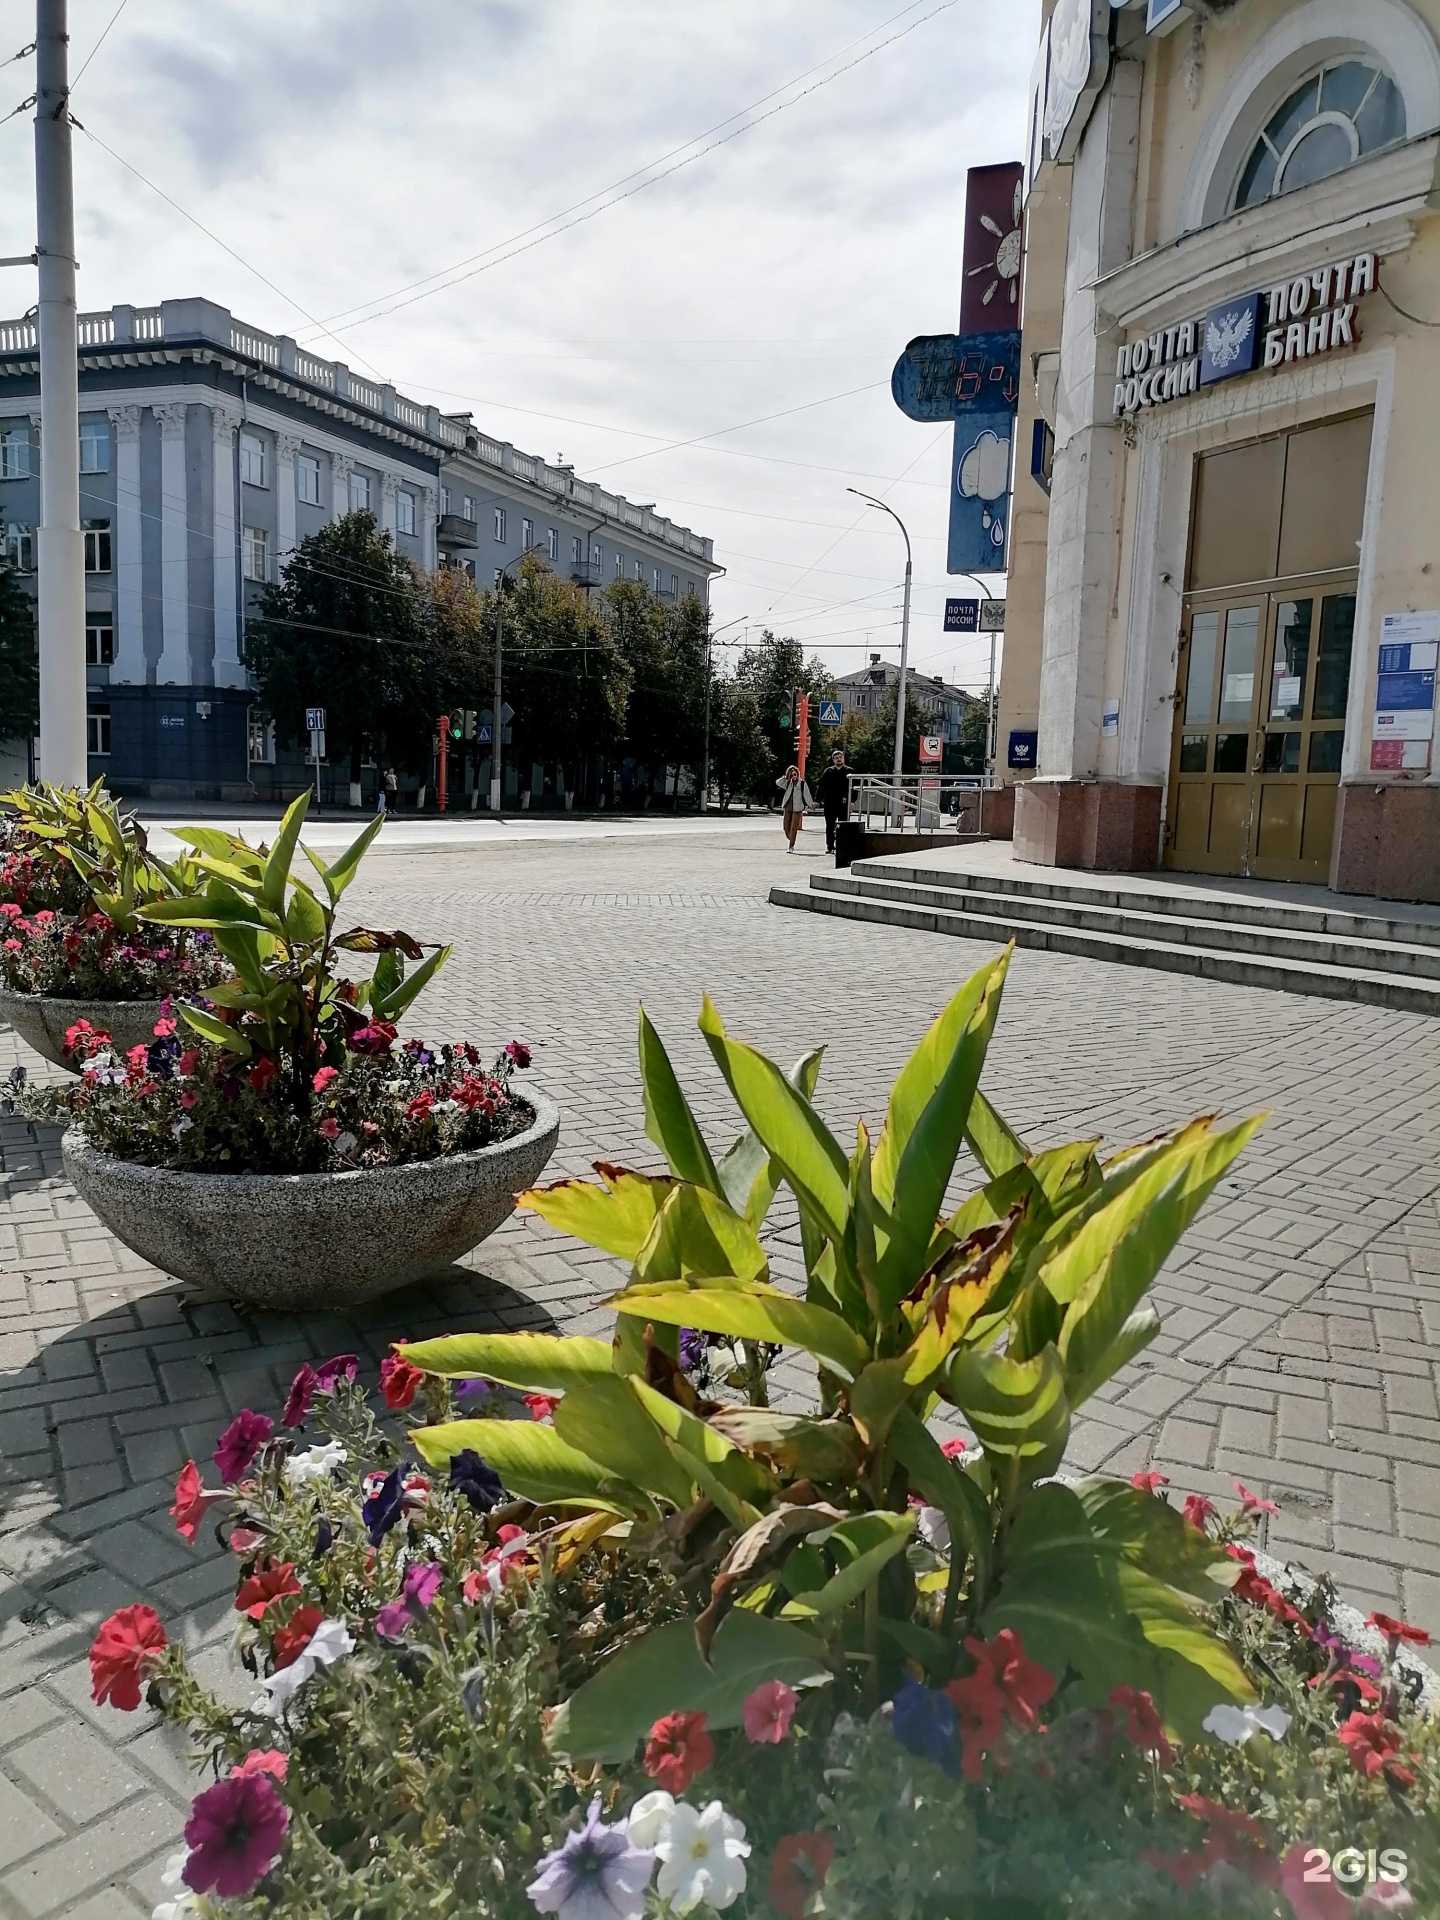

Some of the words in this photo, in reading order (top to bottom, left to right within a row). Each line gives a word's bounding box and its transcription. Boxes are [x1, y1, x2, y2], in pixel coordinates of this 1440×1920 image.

[1268, 253, 1375, 324] ПОЧТА
[1116, 320, 1195, 378] ПОЧТА
[1263, 303, 1354, 368] БАНК
[1112, 357, 1199, 415] РОССИИ
[947, 616, 974, 625] РОССИИ
[948, 606, 974, 615] ПОЧТА
